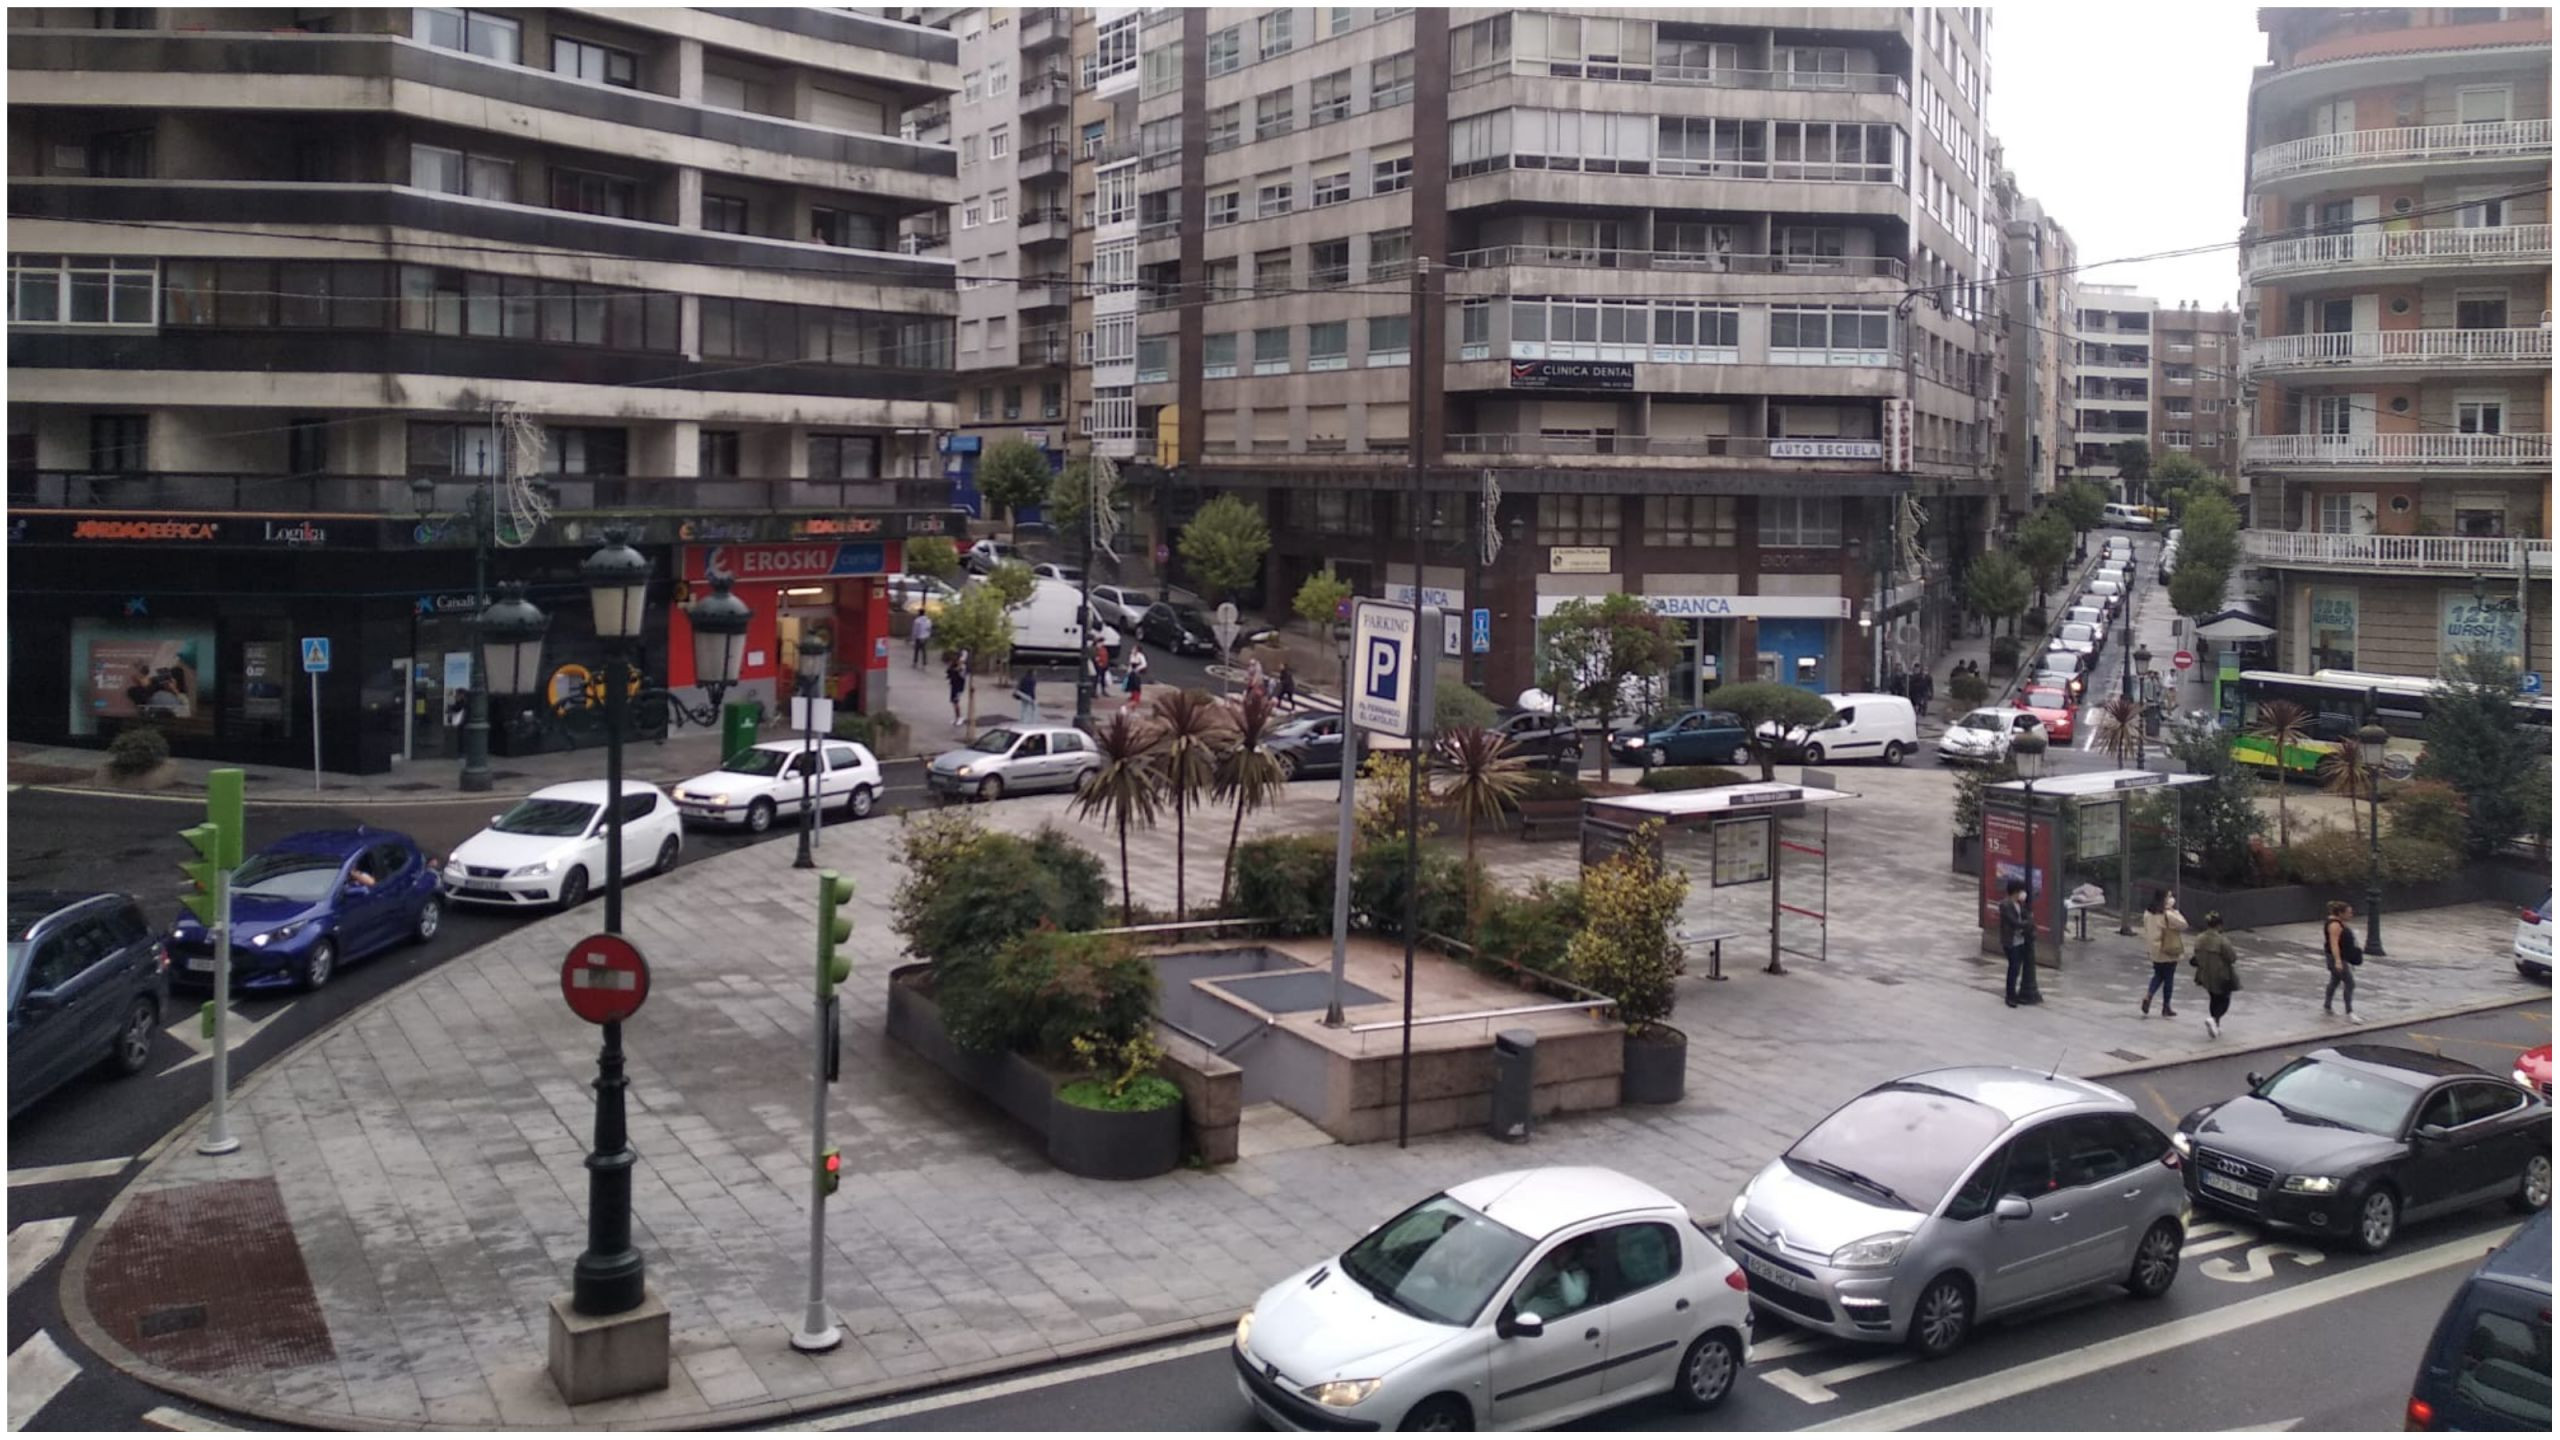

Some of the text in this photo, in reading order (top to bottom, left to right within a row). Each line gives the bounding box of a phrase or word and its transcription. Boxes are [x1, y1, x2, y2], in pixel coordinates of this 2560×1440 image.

[1543, 364, 1633, 377] CLINICA DENTAL
[1775, 444, 1879, 456] AUTO ESCUELA
[743, 551, 826, 571] EROSKI
[1363, 613, 1409, 633] PARKING
[2448, 624, 2496, 638] WASH
[1370, 641, 1396, 693] P
